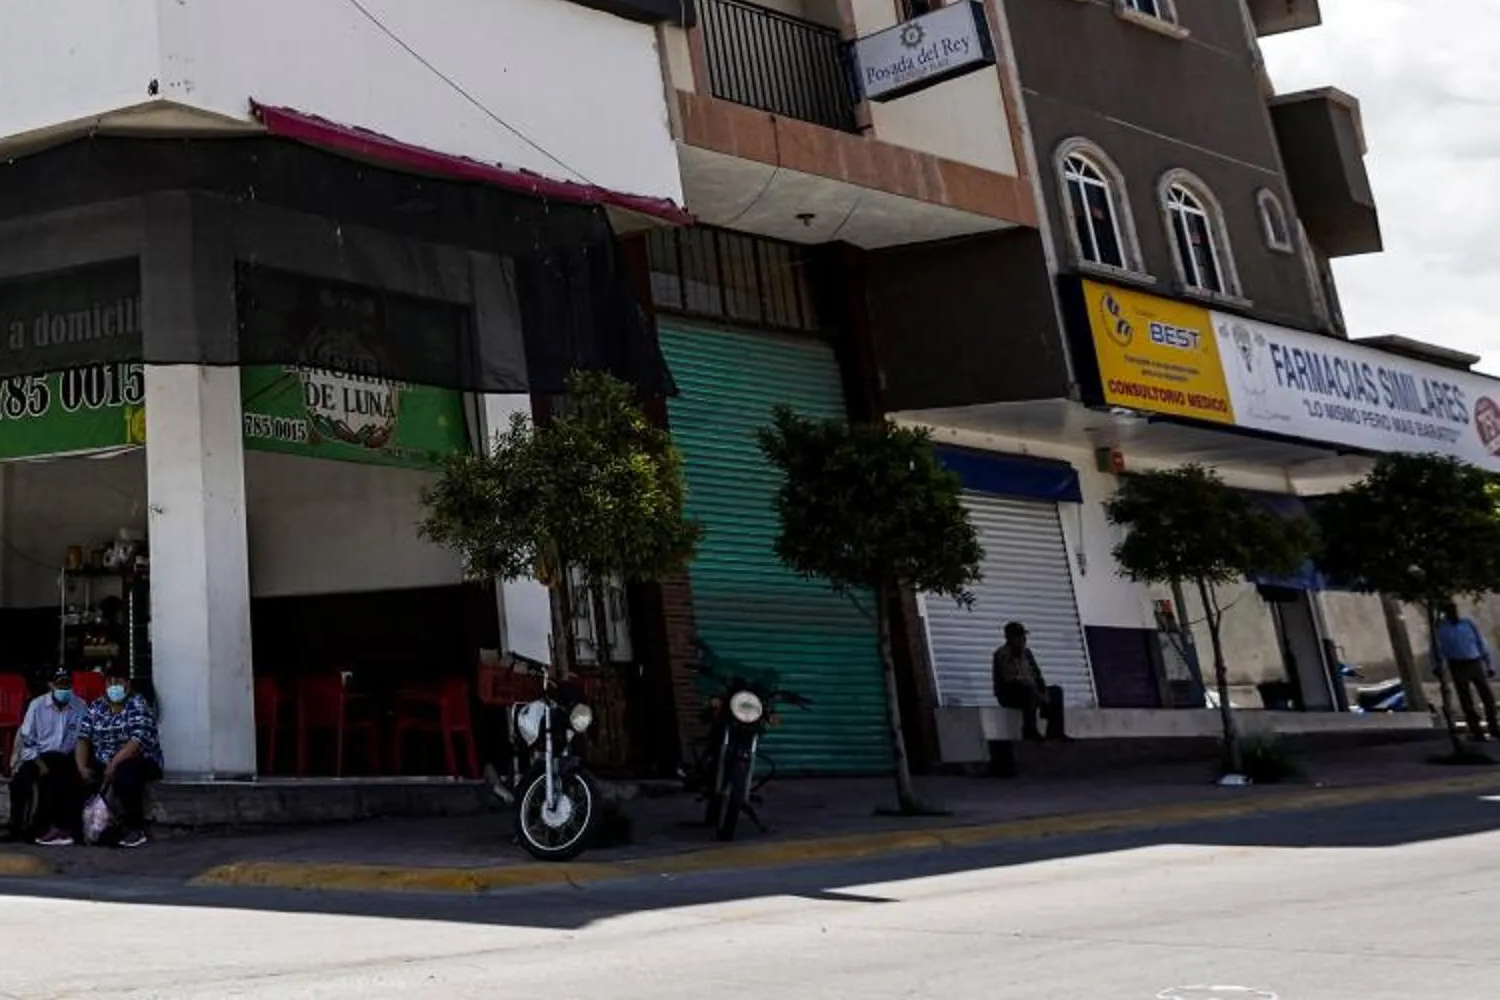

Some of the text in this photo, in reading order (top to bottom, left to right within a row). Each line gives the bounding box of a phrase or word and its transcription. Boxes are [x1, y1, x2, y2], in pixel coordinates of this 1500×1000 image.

[867, 56, 915, 84] Posada
[918, 43, 939, 64] del
[941, 36, 969, 56] Rey
[9, 320, 24, 349] a
[1149, 321, 1200, 350] BEST
[60, 361, 145, 413] 0015
[304, 381, 396, 418] DE LUNA
[1268, 343, 1470, 425] FARMACIAS SIMILARES
[244, 412, 309, 442] 785 0015
